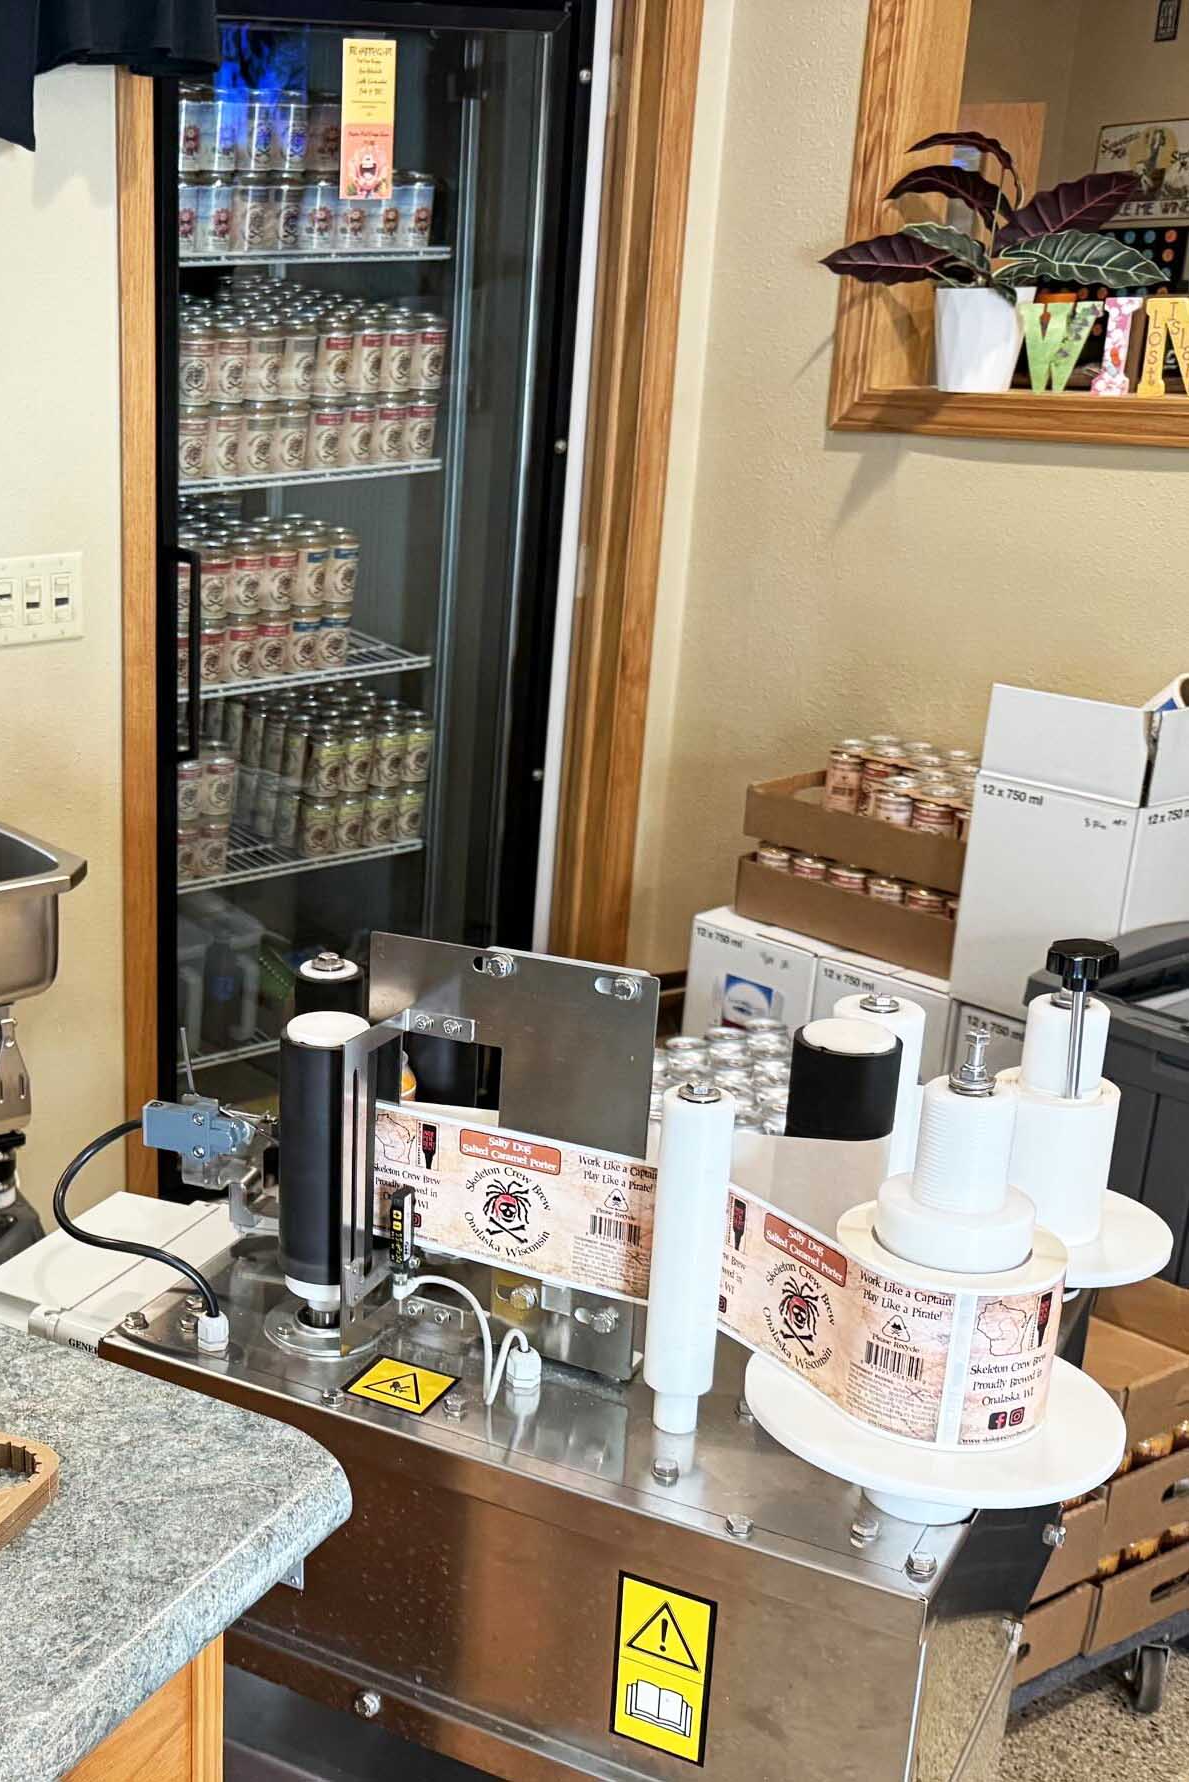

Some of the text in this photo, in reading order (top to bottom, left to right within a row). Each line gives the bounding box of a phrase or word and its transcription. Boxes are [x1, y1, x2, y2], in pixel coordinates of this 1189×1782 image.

[982, 784, 994, 796] 12
[1006, 788, 1027, 802] 750
[1029, 795, 1044, 806] ml
[1147, 814, 1159, 825] 12
[1166, 809, 1183, 822] 750
[696, 927, 706, 937] 12
[824, 967, 834, 979] 12
[843, 975, 860, 987] 750
[862, 980, 875, 991] ml
[966, 1015, 978, 1027] 12
[488, 1137, 532, 1155] Salty Dog
[462, 1143, 558, 1172] Salted Caramel Porter
[579, 1155, 601, 1168] Work
[603, 1160, 621, 1172] Like
[622, 1166, 628, 1174] a
[375, 1176, 400, 1190] Proudly
[402, 1170, 421, 1182] Crew
[423, 1174, 441, 1185] Brew
[583, 1170, 600, 1183] Play
[602, 1174, 619, 1186] Like
[465, 1166, 552, 1212] Skeleton Crew Brew
[464, 1211, 552, 1258] Onalaska Wisconsin
[788, 1227, 824, 1257] Salty Dog
[766, 1231, 844, 1282] Salted Caramel Porter
[765, 1262, 835, 1326] Skeleton Crew Brew
[860, 1270, 952, 1307] Work Like a Captain
[863, 1288, 943, 1321] Play Like a Pirate!
[68, 1337, 97, 1354] GENE
[762, 1306, 792, 1359] Onalaska
[795, 1347, 833, 1371] Wisconsin
[969, 1361, 1009, 1376] Skeleton
[1010, 1360, 1031, 1373] Crew
[972, 1377, 1007, 1391] Proudly
